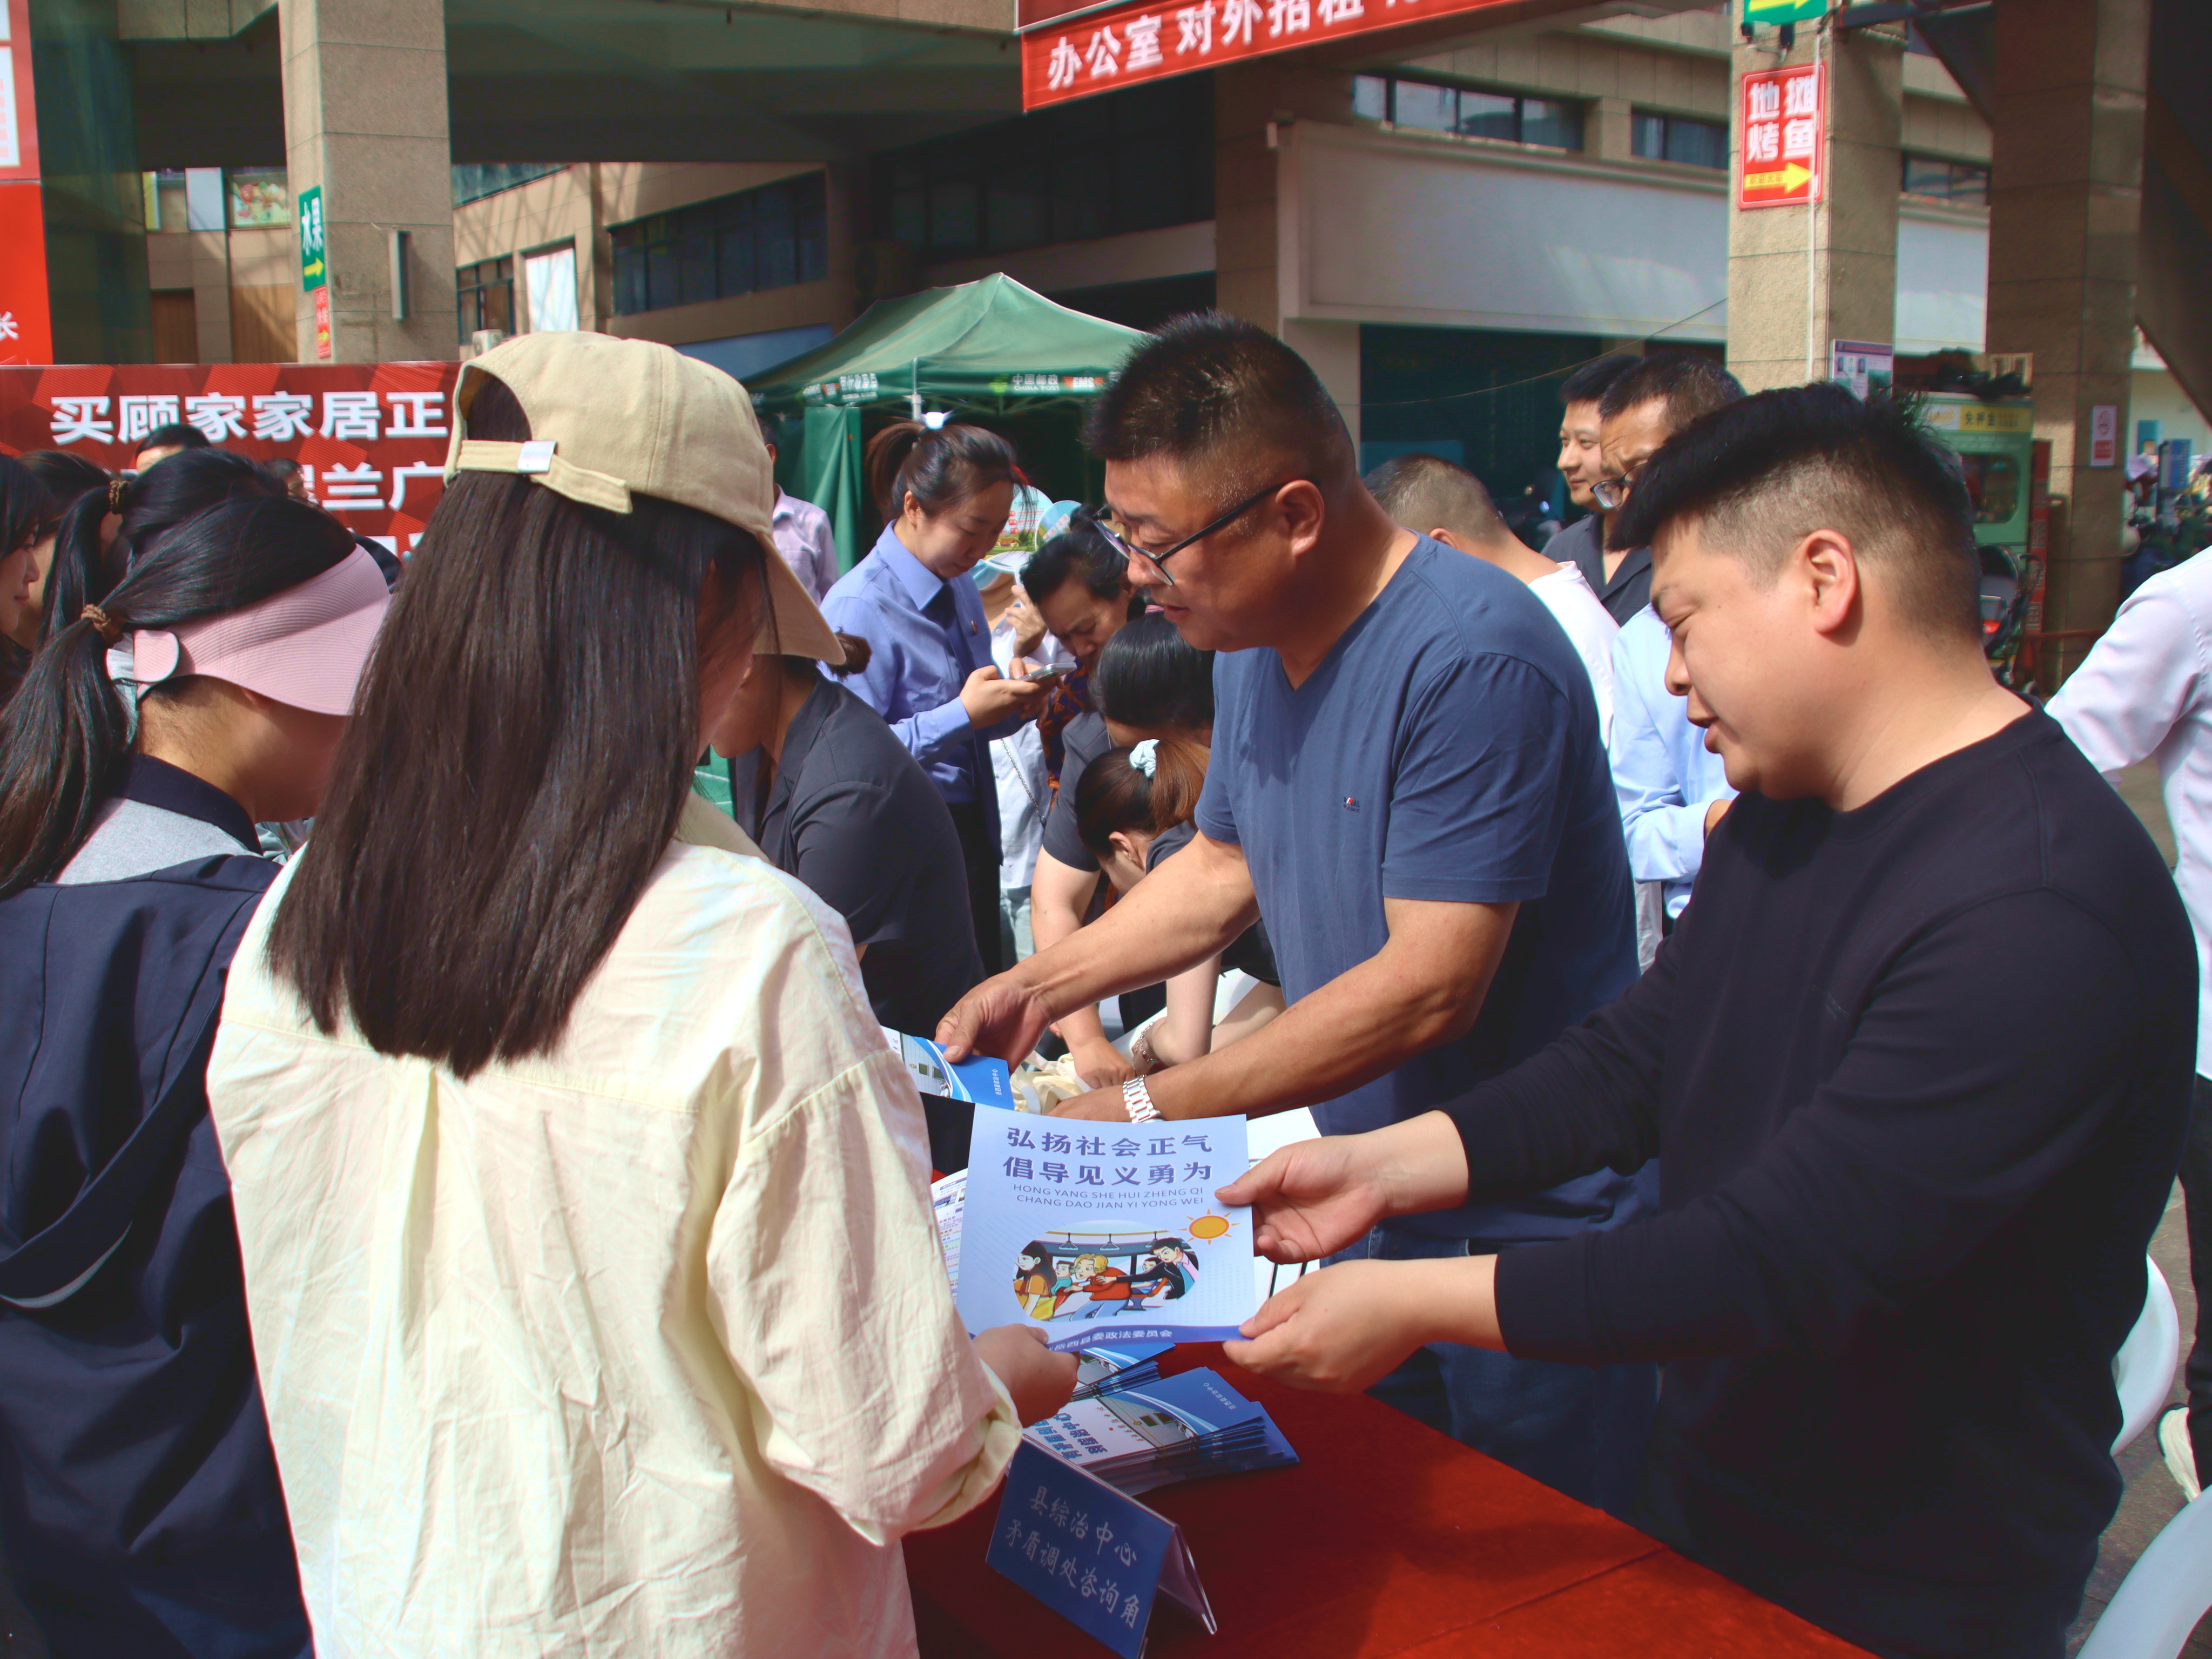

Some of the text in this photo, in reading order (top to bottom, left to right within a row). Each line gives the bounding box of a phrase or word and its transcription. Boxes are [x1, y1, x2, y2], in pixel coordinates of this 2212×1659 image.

[1047, 14, 1164, 91] 办公室
[1748, 75, 1816, 121] 地摊
[1746, 118, 1813, 161] 烤鱼
[1749, 172, 1784, 185] 欢迎光临
[1013, 374, 1058, 385] 中国邮政
[1071, 377, 1095, 388] EMS
[50, 390, 448, 446] 买顾家家居正
[1007, 1127, 1213, 1157] 弘扬社会正气
[1002, 1156, 1212, 1186] 倡导见义勇为
[1013, 1183, 1051, 1195] HONG
[1055, 1189, 1088, 1198] YANG
[1118, 1191, 1140, 1199] HUI
[1144, 1188, 1186, 1198] ZHENG
[1190, 1186, 1203, 1196] QI
[1016, 1195, 1062, 1207] CHANG
[1065, 1199, 1092, 1209] DAO
[1095, 1201, 1123, 1209] JIAN
[1141, 1198, 1177, 1208] YONG
[1181, 1196, 1204, 1205] WEI
[1049, 1330, 1172, 1351] 岳西县委政法委员会
[1029, 1485, 1137, 1567] 县综治中心
[1005, 1518, 1139, 1629] 矛盾调处咨询角
